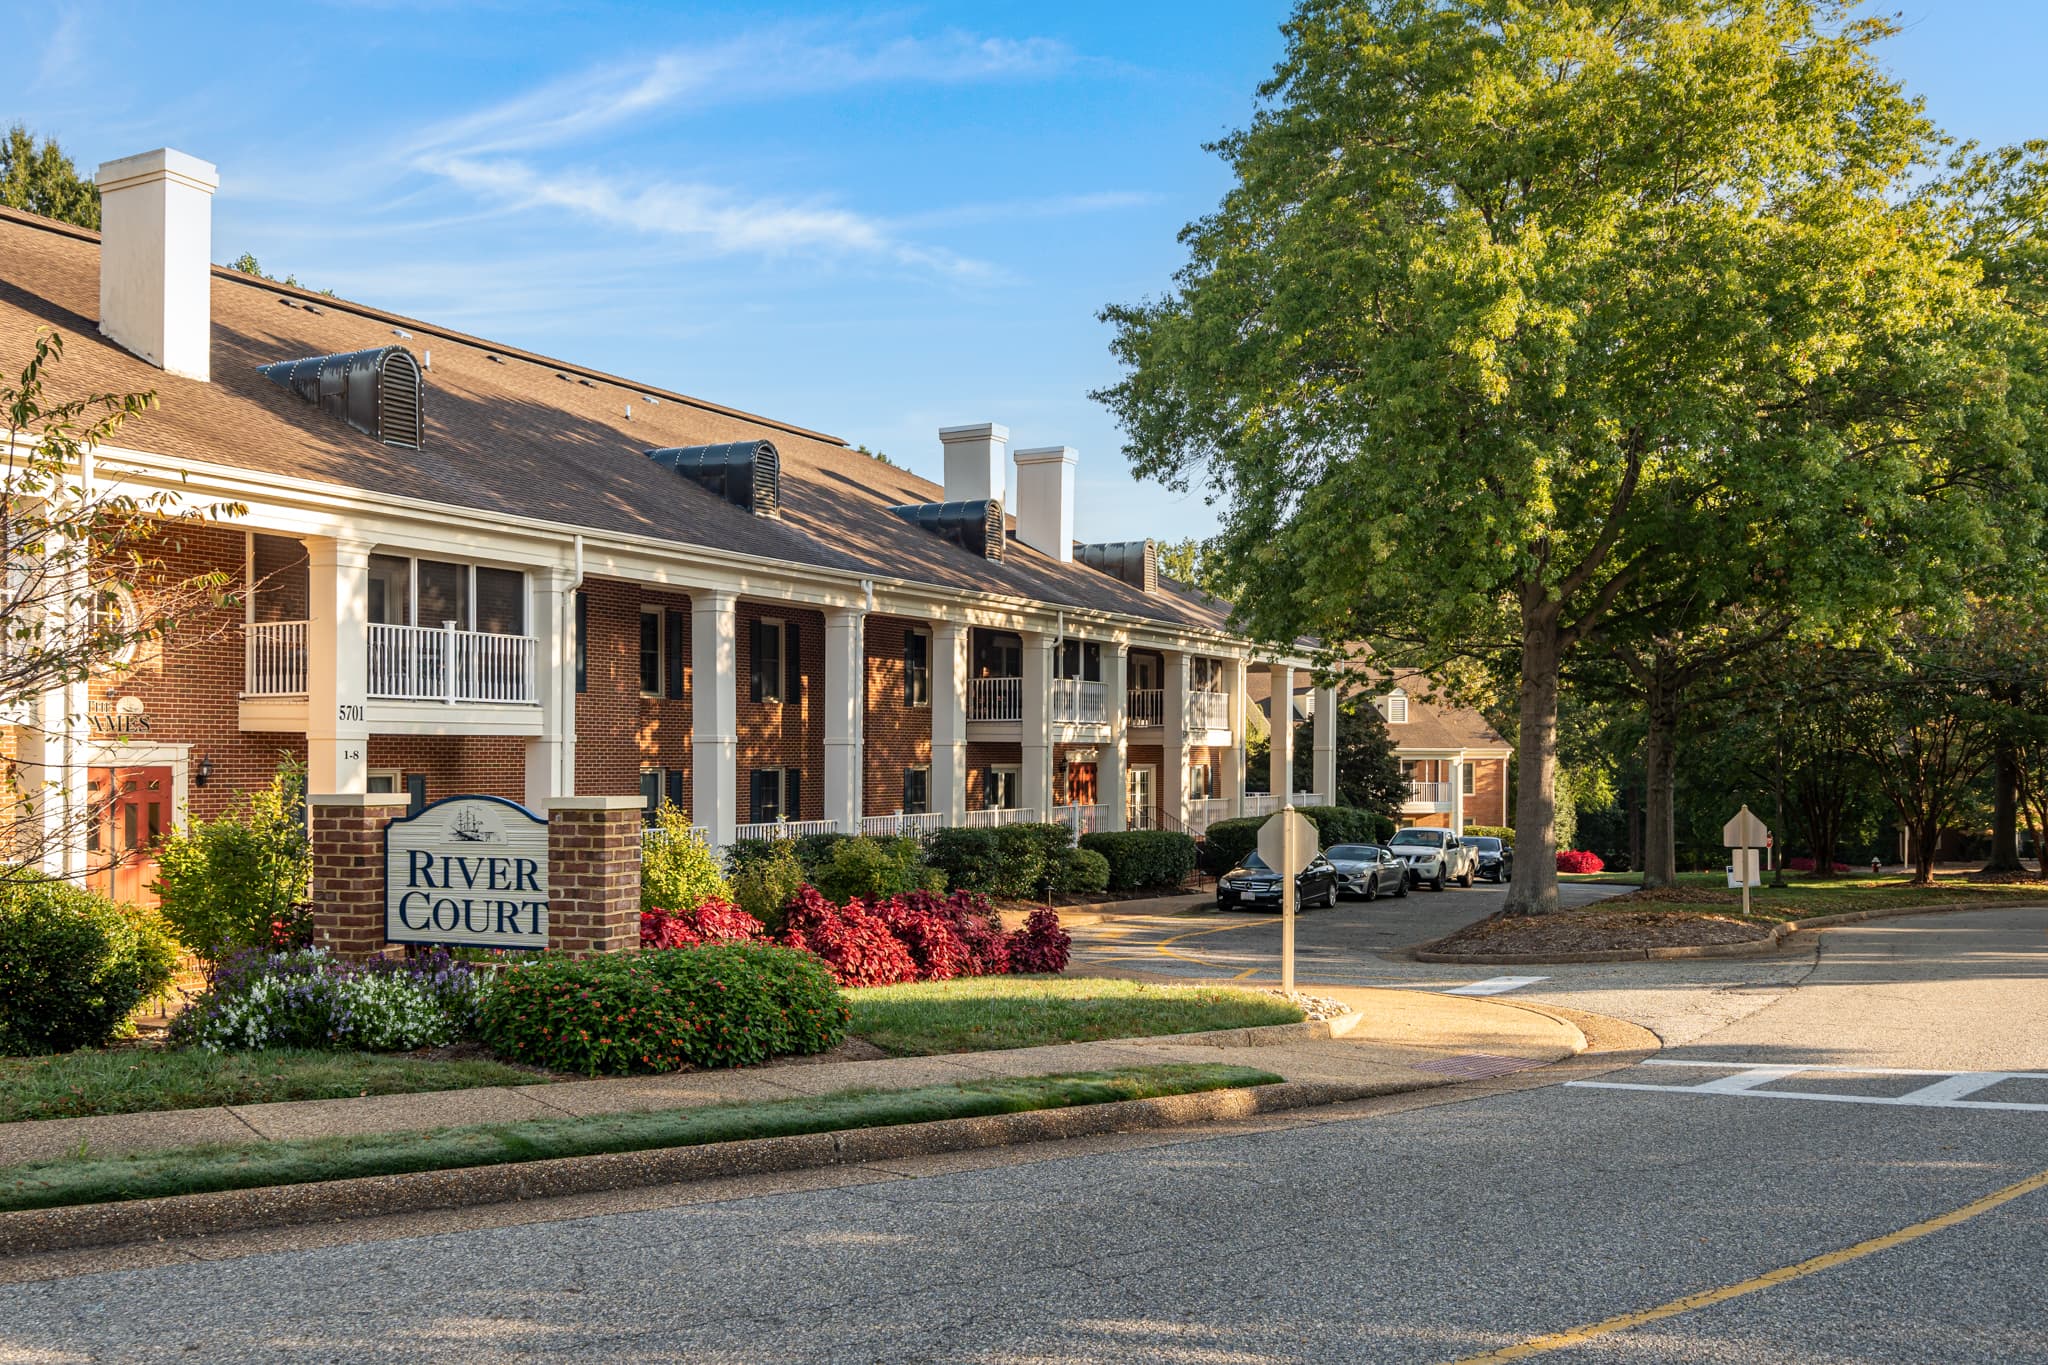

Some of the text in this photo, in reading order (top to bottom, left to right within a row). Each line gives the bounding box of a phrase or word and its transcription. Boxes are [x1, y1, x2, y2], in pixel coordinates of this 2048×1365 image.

[339, 705, 363, 721] 5701
[90, 715, 150, 732] AMES
[344, 750, 359, 760] 1-8
[406, 850, 542, 891] RIVER
[399, 891, 549, 935] COURT
